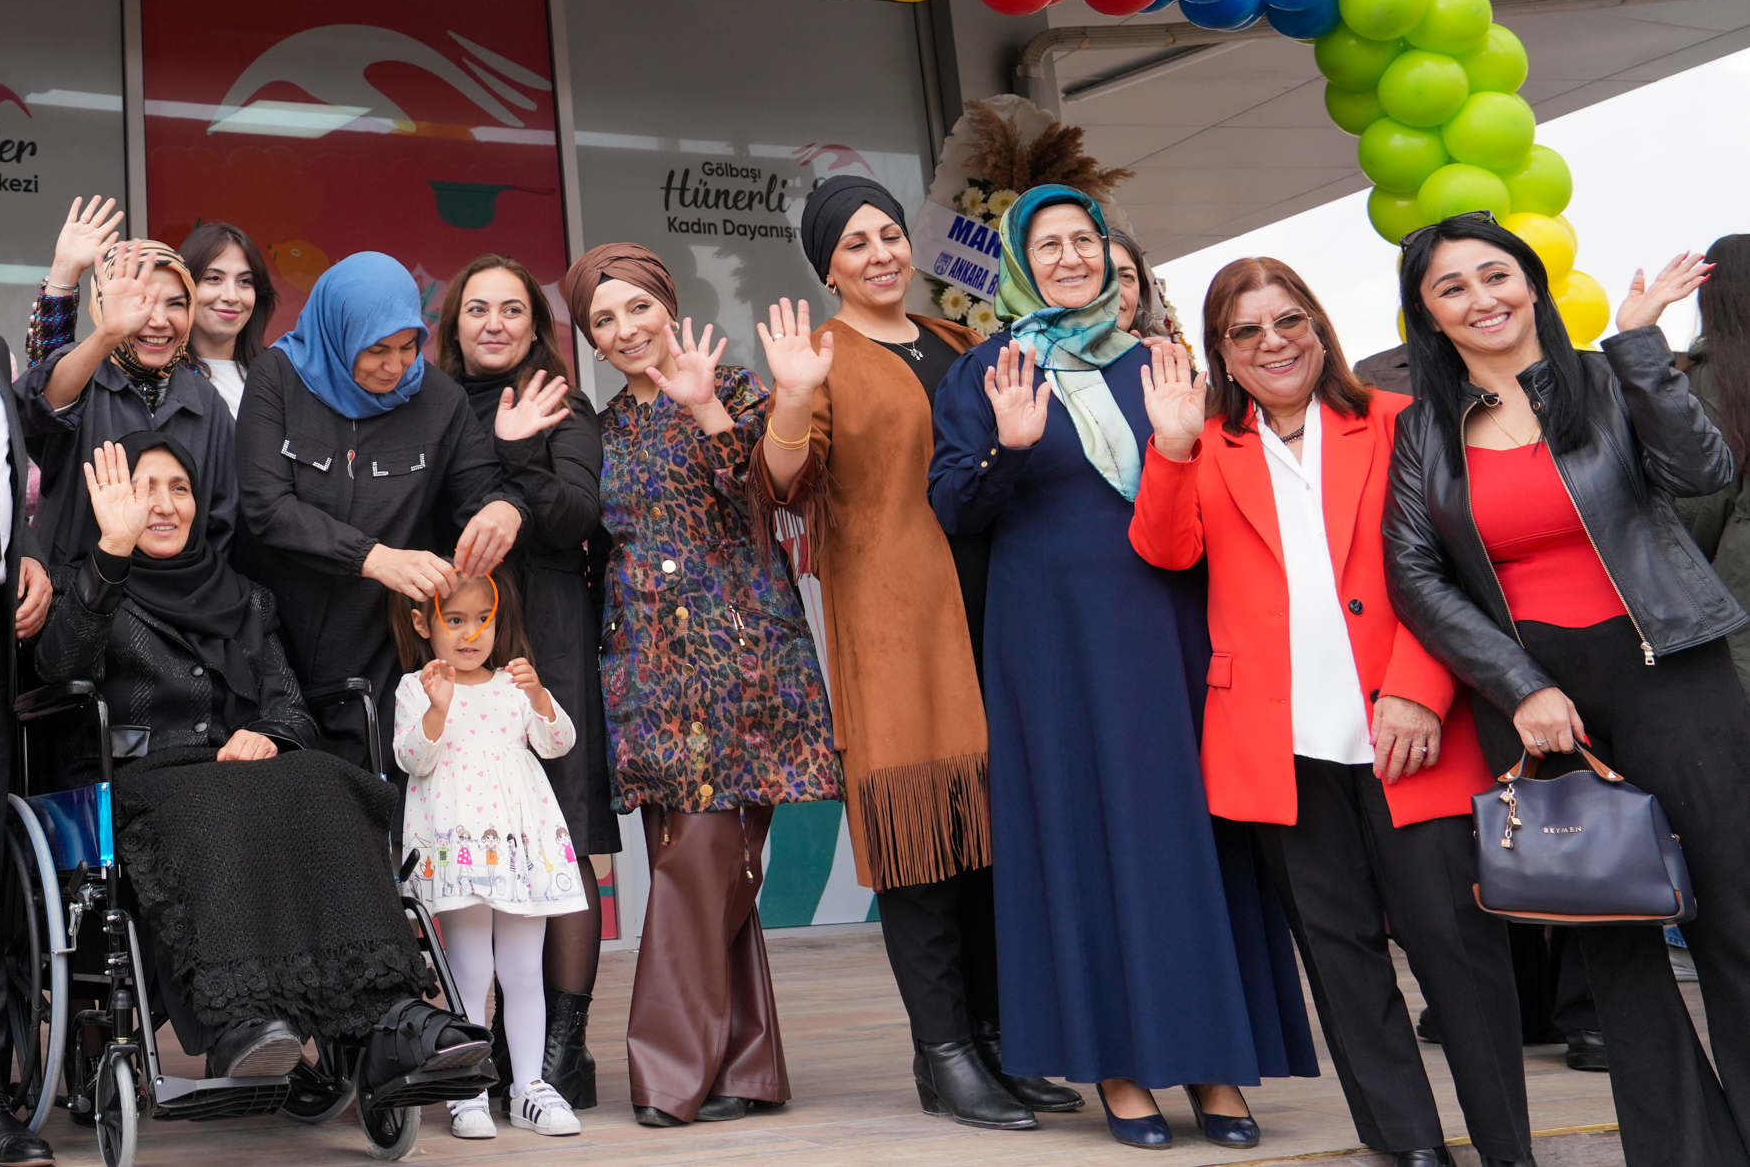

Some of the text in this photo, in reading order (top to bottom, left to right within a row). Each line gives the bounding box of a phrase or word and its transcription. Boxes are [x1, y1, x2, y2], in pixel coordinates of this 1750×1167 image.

[702, 161, 762, 182] Gölbaşı
[660, 168, 791, 213] Hünerli
[667, 216, 717, 235] Kadın
[948, 215, 1002, 259] MAN
[948, 257, 989, 291] ANKARA
[1543, 825, 1582, 834] BEYMEN
